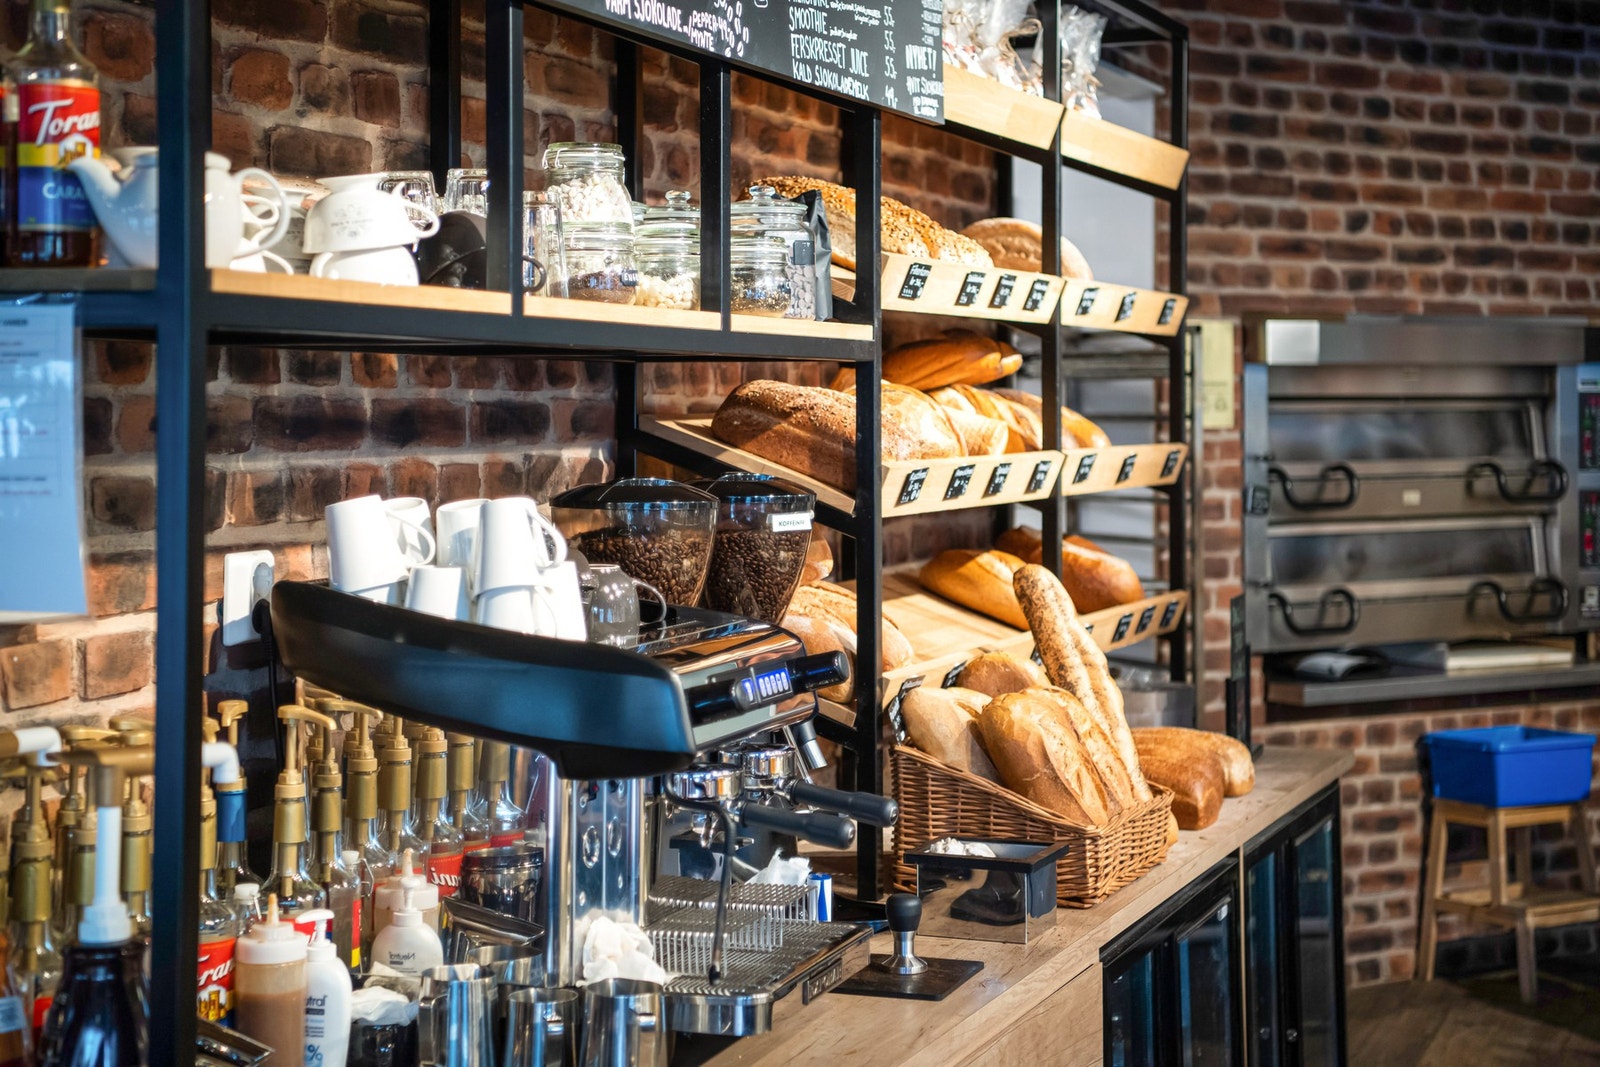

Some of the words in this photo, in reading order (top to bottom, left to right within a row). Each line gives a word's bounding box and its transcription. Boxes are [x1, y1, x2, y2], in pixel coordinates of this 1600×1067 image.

[634, 0, 683, 32] SJOKOLADE
[788, 6, 828, 35] SMOOTHIE
[691, 27, 715, 52] MYNTE
[790, 33, 847, 69] FERSKPRESSET
[849, 48, 869, 78] JUICE
[792, 58, 812, 83] KALD
[28, 98, 100, 147] Toran
